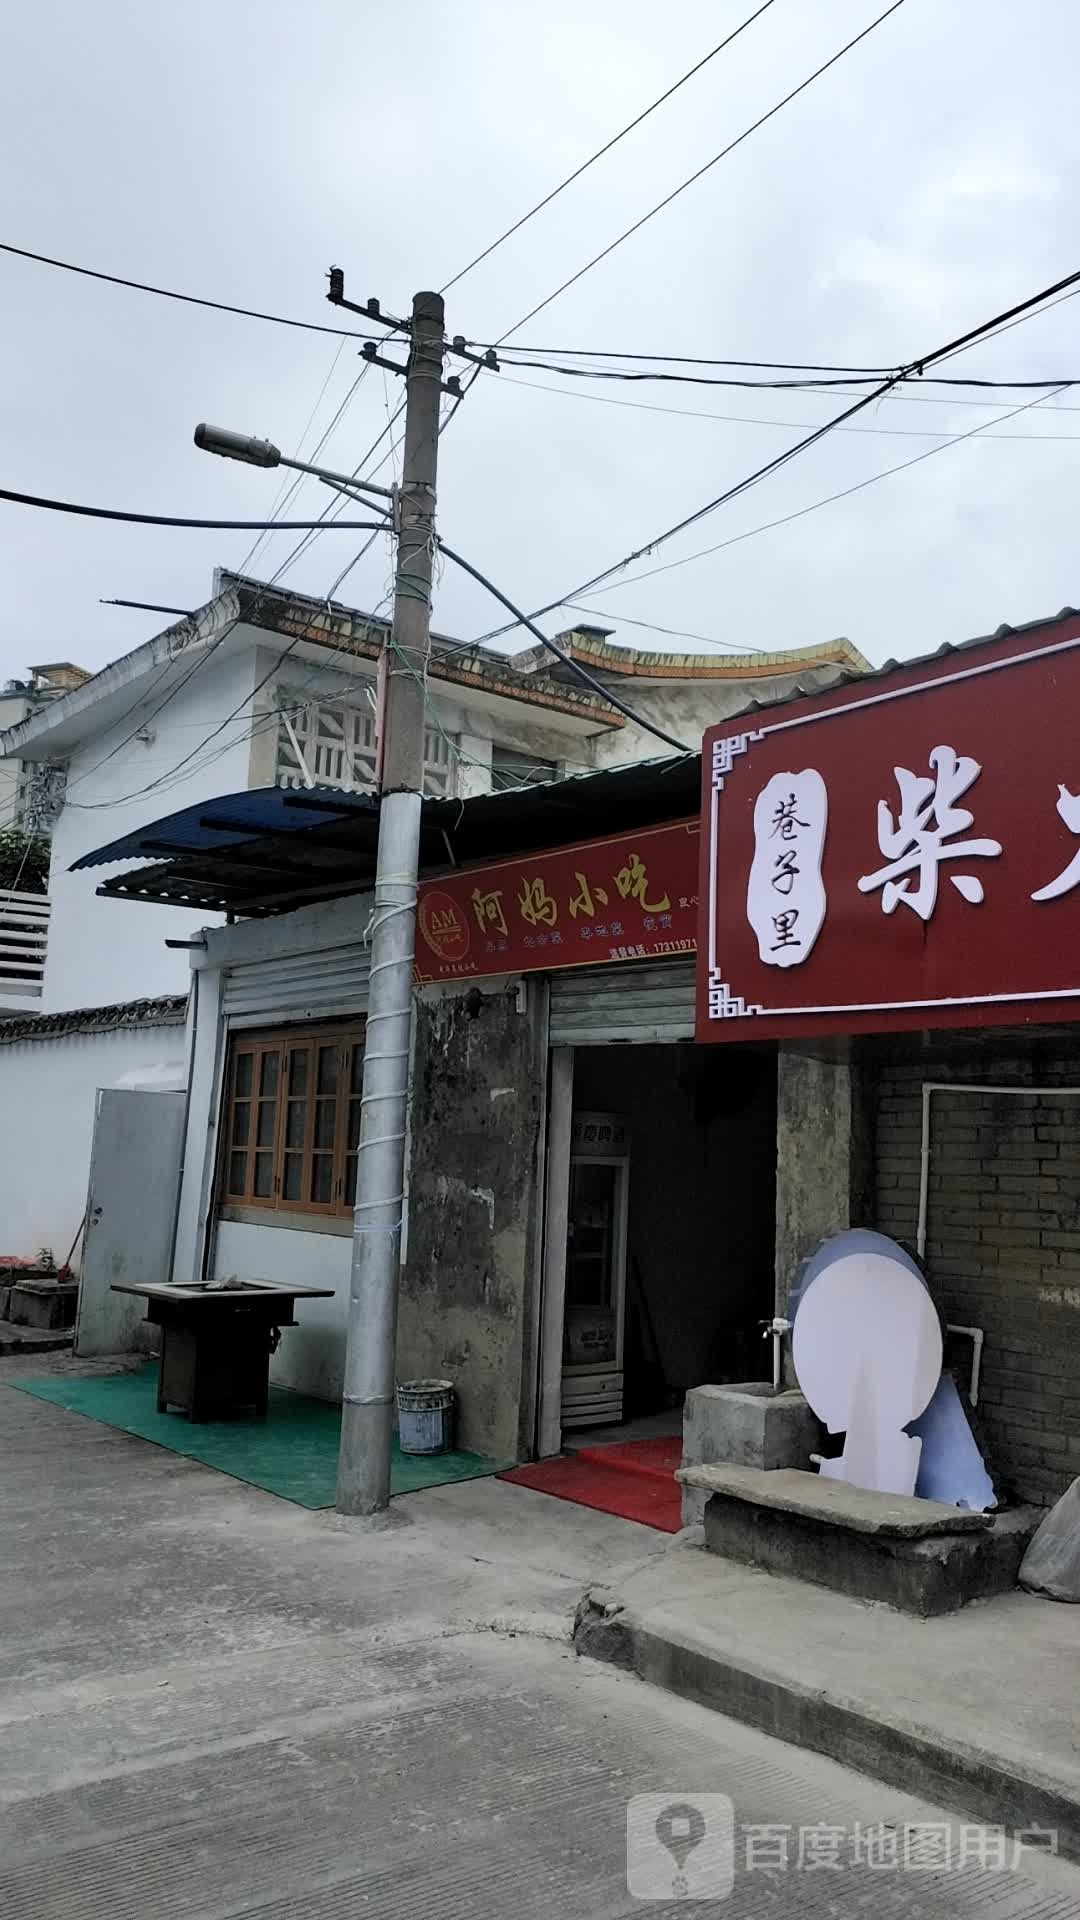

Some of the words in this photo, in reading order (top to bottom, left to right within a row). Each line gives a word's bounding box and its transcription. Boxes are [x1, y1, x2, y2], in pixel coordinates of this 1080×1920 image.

[471, 852, 671, 937] 阿妈小吃
[768, 793, 811, 953] 巷子里
[431, 909, 458, 930] AM
